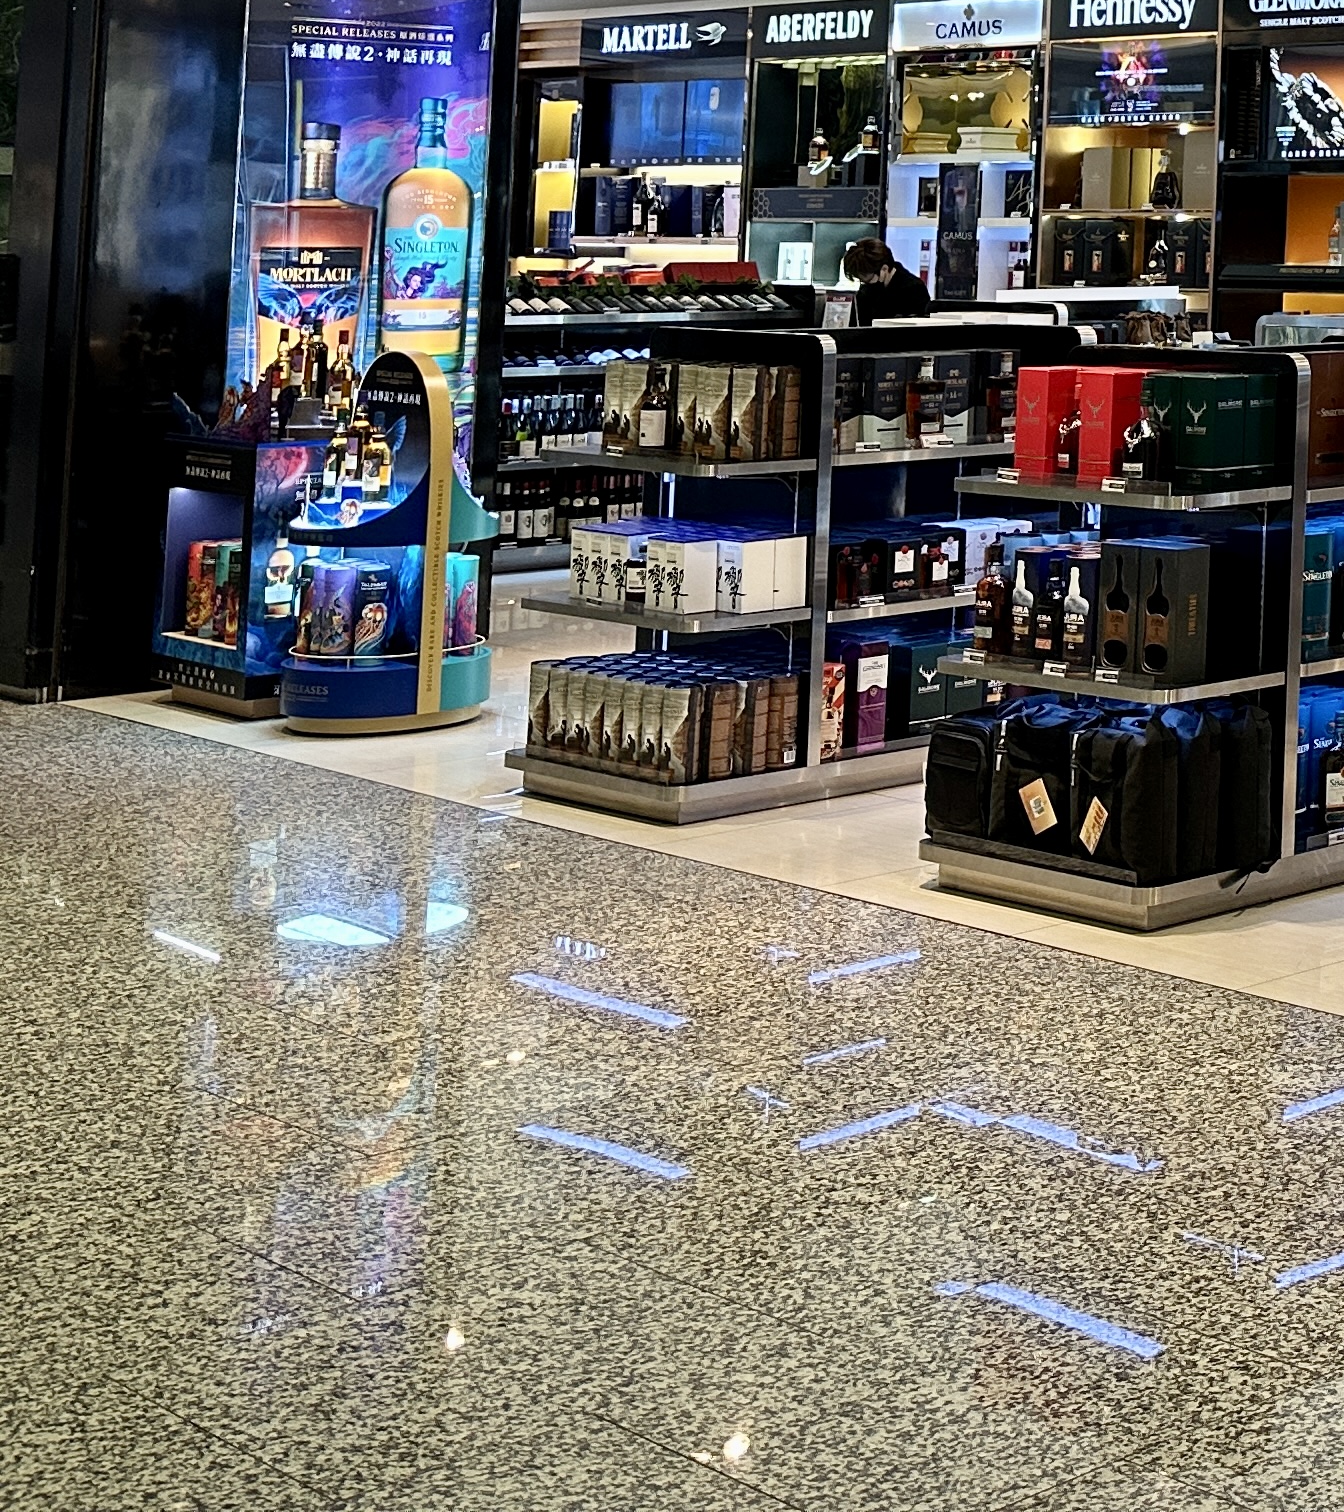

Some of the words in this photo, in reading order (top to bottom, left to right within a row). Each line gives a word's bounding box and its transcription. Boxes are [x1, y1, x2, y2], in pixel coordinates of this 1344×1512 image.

[291, 24, 339, 37] SPECIAL
[341, 26, 397, 39] RELEASES
[766, 9, 873, 43] ABERFELDY
[936, 20, 1002, 39] CAMUS
[601, 22, 692, 54] MARTELL
[943, 231, 973, 240] CAMUS
[394, 238, 459, 254] SINGLETON
[270, 267, 351, 282] MORTLACH
